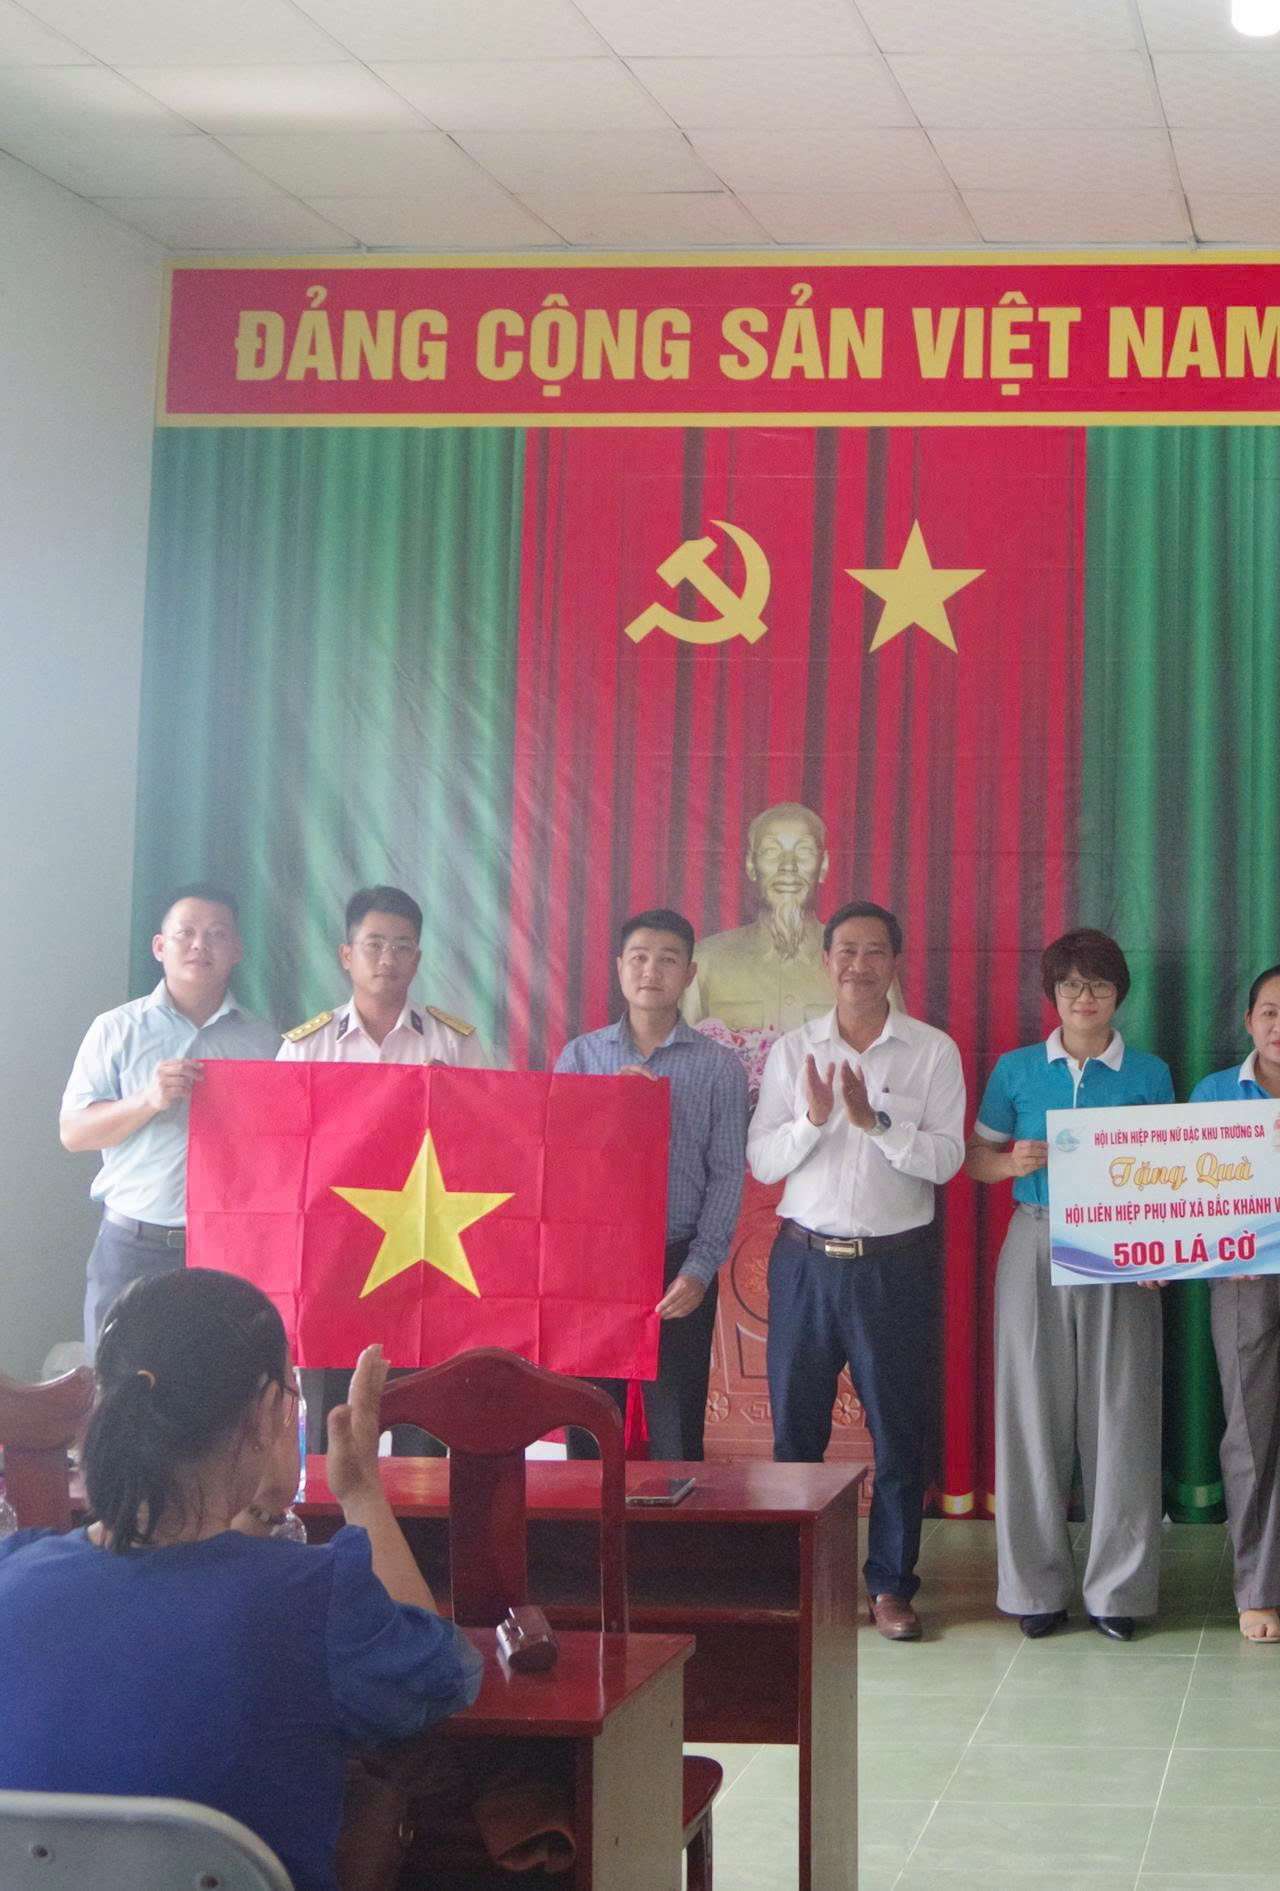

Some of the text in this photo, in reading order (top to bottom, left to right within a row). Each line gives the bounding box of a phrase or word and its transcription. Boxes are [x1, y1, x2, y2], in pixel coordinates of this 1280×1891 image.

[235, 285, 448, 381] ĐẢNG
[477, 294, 691, 396] CỘNG
[719, 283, 884, 380] SẢN
[912, 291, 1081, 395] VIỆT
[1094, 1129, 1108, 1148] HỘI
[1110, 1129, 1128, 1144] LIÊN
[1130, 1128, 1149, 1146] HIỆP
[1151, 1130, 1167, 1145] PHỤ
[1183, 1127, 1200, 1144] ĐẶC
[1202, 1127, 1217, 1140] KHU
[1255, 1125, 1265, 1137] SA
[1109, 1152, 1254, 1191] Tặng Quà
[1065, 1204, 1084, 1228] HỘI
[1087, 1203, 1112, 1223] LIÊN
[1115, 1200, 1140, 1225] HIỆP
[1145, 1202, 1166, 1223] PHỤ
[1207, 1194, 1230, 1216] BẮC
[1233, 1194, 1271, 1215] KHÁNH
[1114, 1229, 1256, 1267] 500 LÁ CỜ
